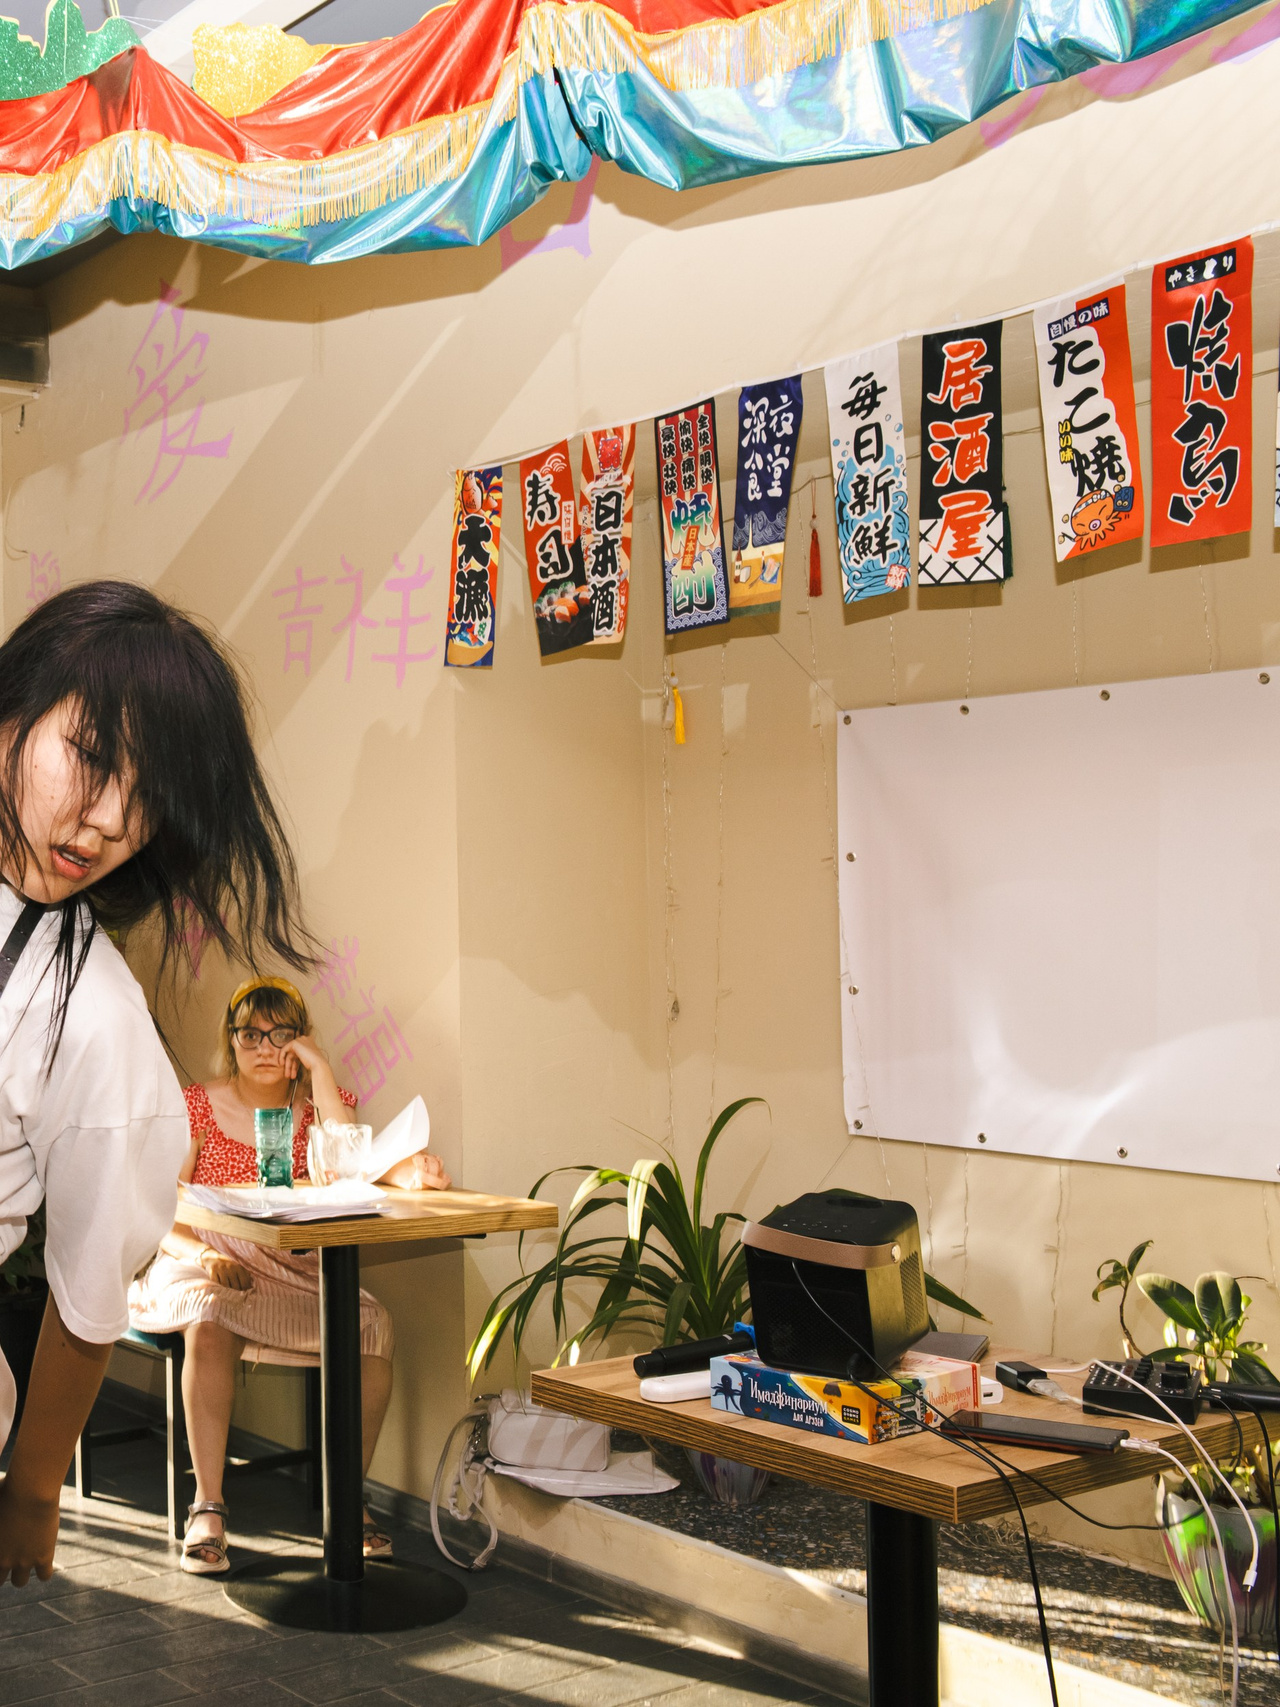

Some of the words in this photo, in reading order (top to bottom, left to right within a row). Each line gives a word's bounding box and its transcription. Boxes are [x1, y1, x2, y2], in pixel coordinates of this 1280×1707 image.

[1049, 298, 1109, 340] 自慢の味
[1168, 254, 1234, 288] やきとり
[841, 371, 900, 567] 毎日新鮮
[926, 338, 996, 560] 居酒屋
[1048, 339, 1126, 498] たこ焼
[1059, 419, 1074, 464] いい味
[1165, 289, 1241, 525] 焼鳥
[454, 514, 493, 623] 大漁
[524, 469, 572, 583] 寿司
[590, 488, 624, 636] 日本酒
[271, 552, 439, 690] 吉祥
[748, 1377, 829, 1414] Имаджинариум
